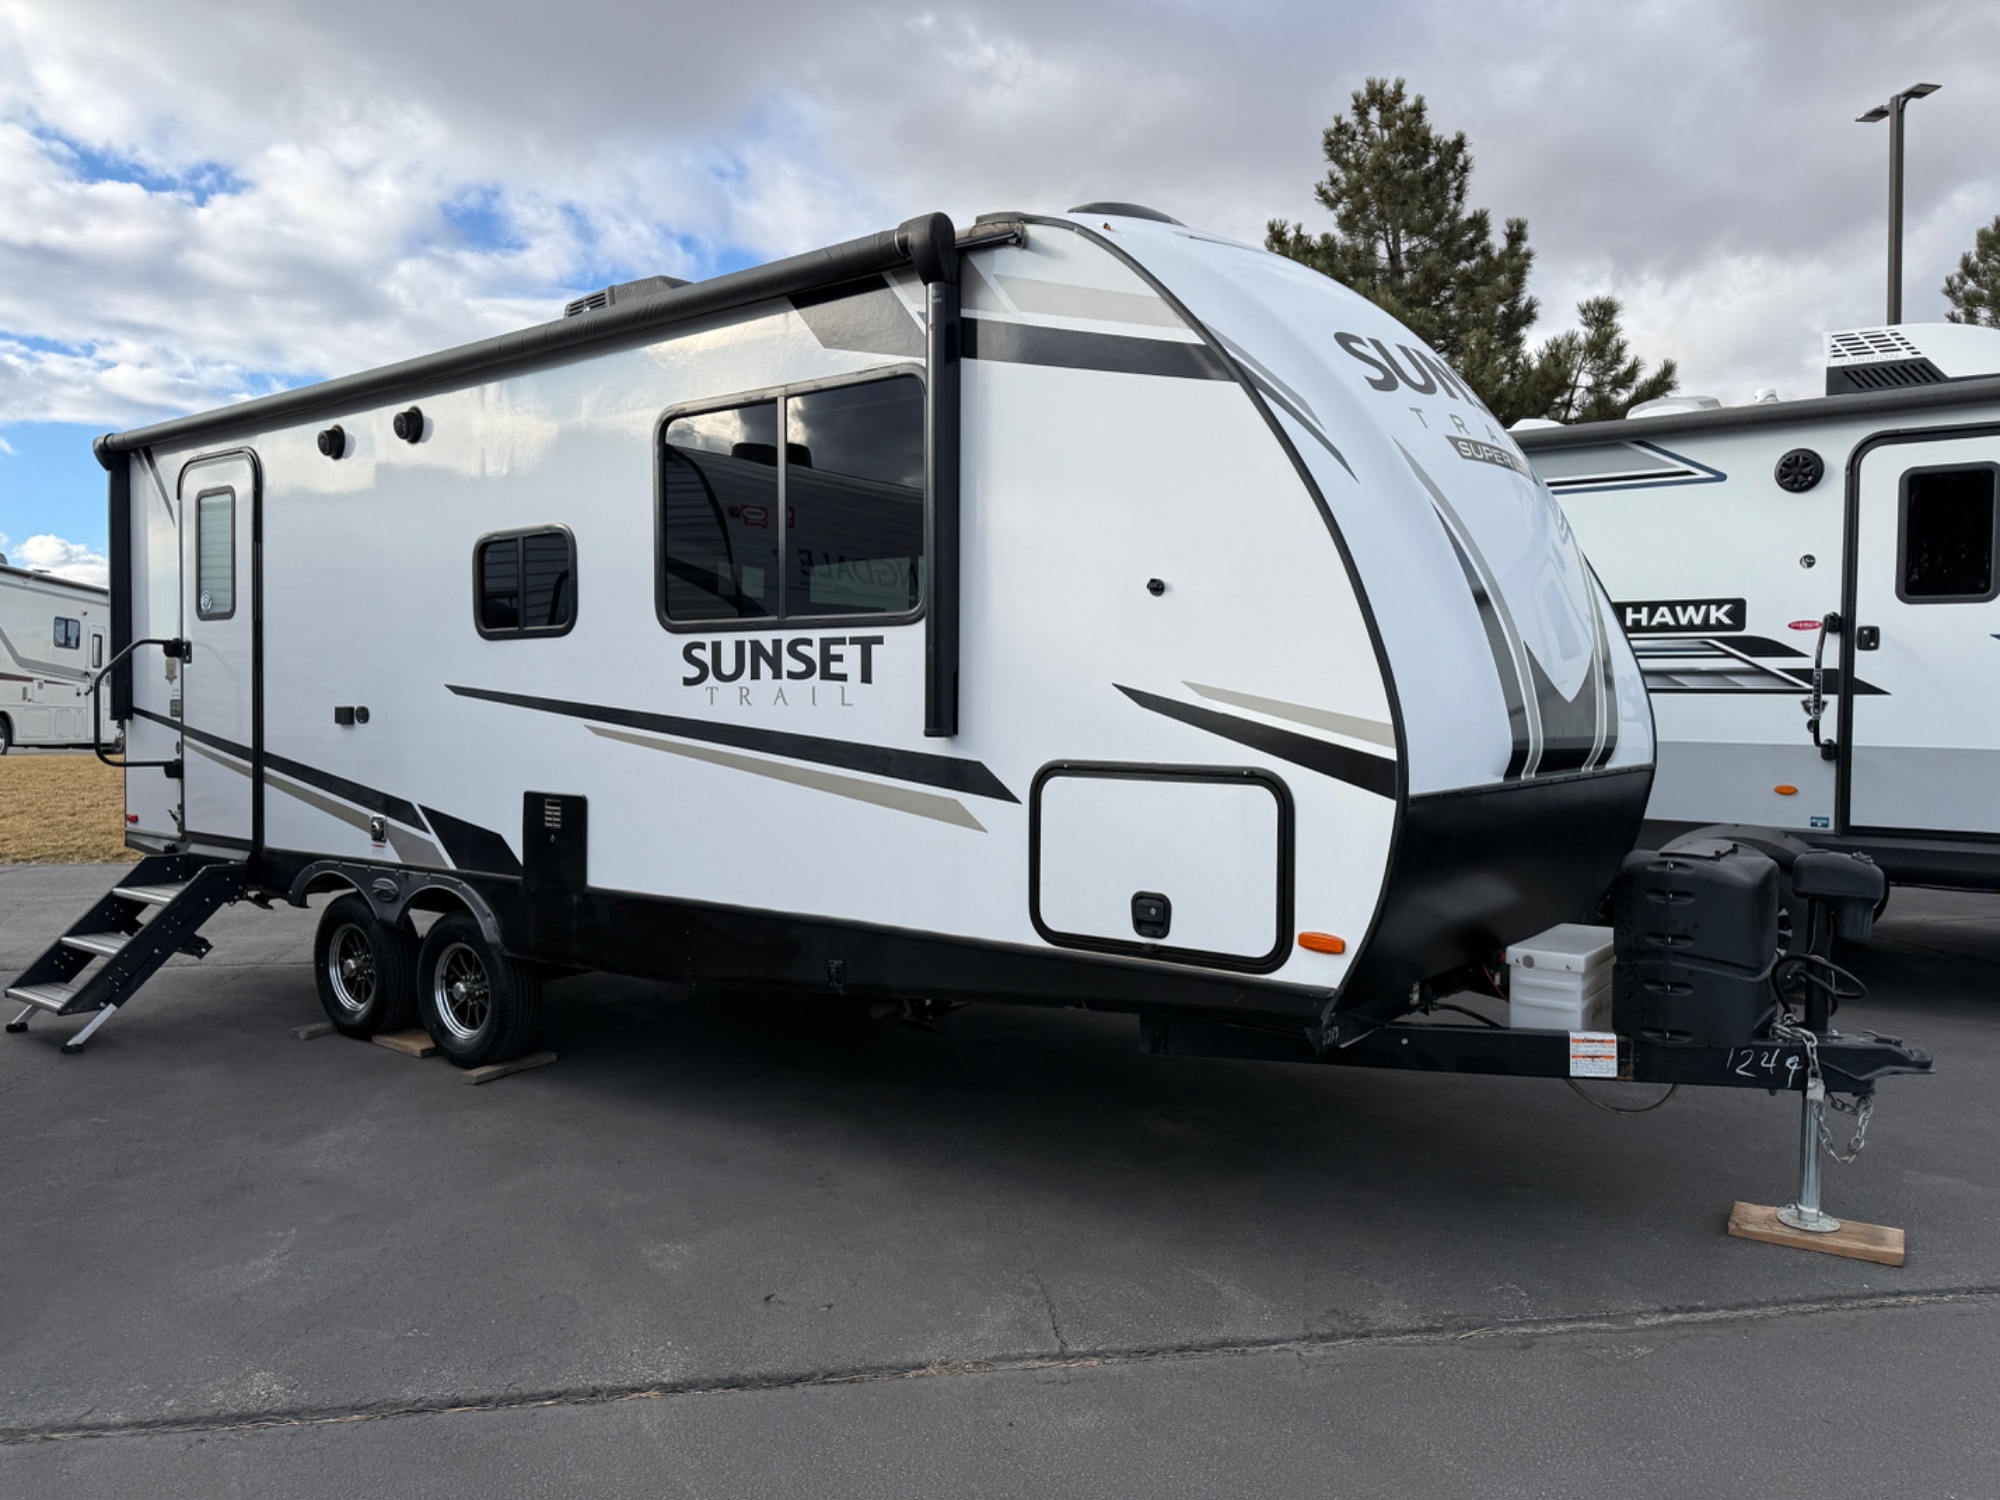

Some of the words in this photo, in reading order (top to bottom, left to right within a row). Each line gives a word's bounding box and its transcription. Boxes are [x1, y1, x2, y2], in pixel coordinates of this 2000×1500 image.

[1333, 331, 1494, 416] SUN
[1408, 406, 1501, 444] TRA
[1457, 440, 1514, 468] SUPER
[1625, 604, 1735, 627] HAWK
[682, 634, 885, 687] SUNSET
[706, 686, 854, 707] TRAIL
